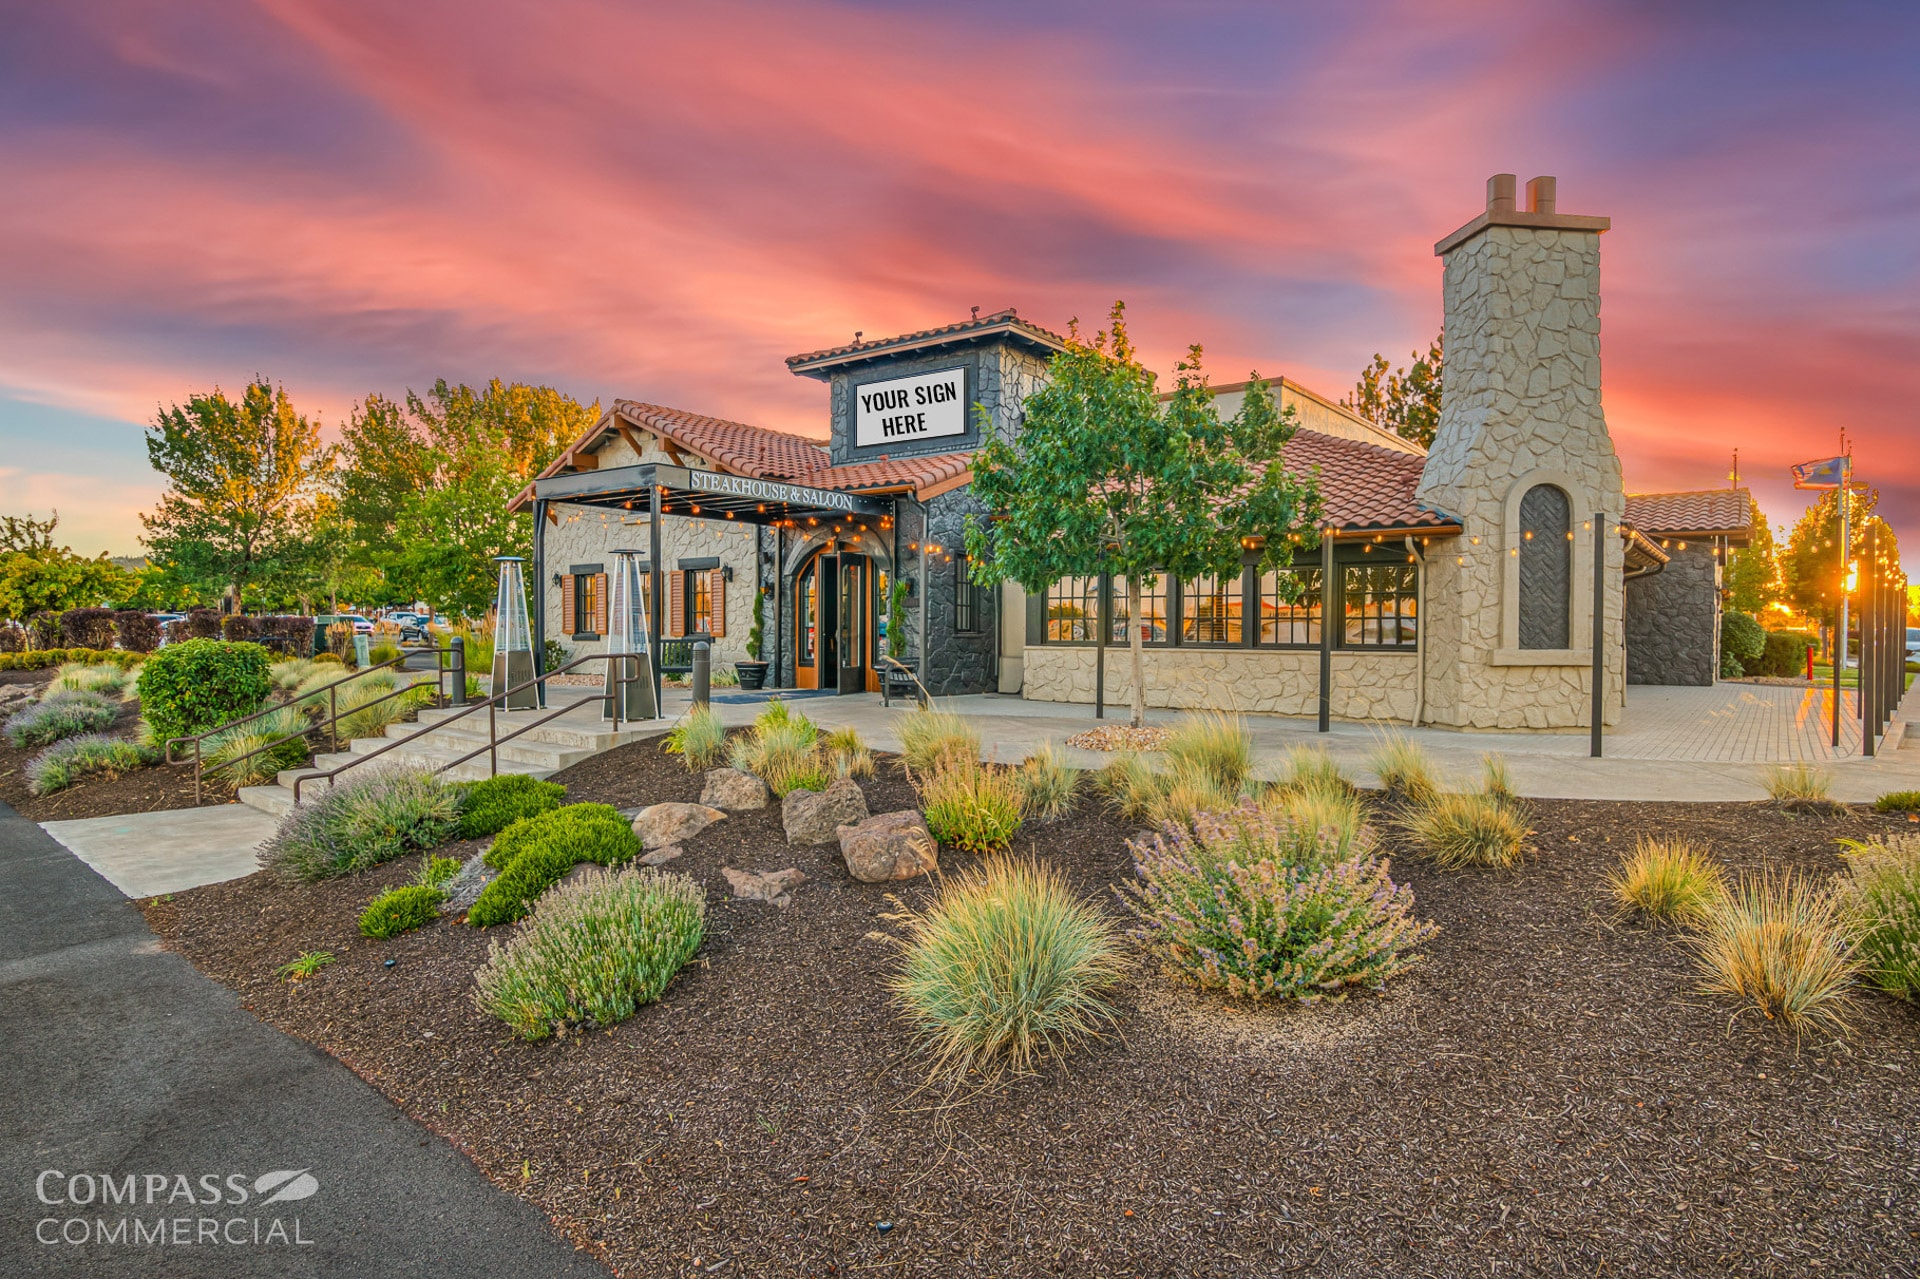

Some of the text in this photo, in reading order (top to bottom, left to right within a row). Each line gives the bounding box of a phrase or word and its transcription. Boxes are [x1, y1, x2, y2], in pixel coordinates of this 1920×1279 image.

[861, 382, 956, 413] YOUR SIGN
[882, 413, 927, 437] HERE
[690, 472, 853, 510] STEAKHOUSE & SALOON
